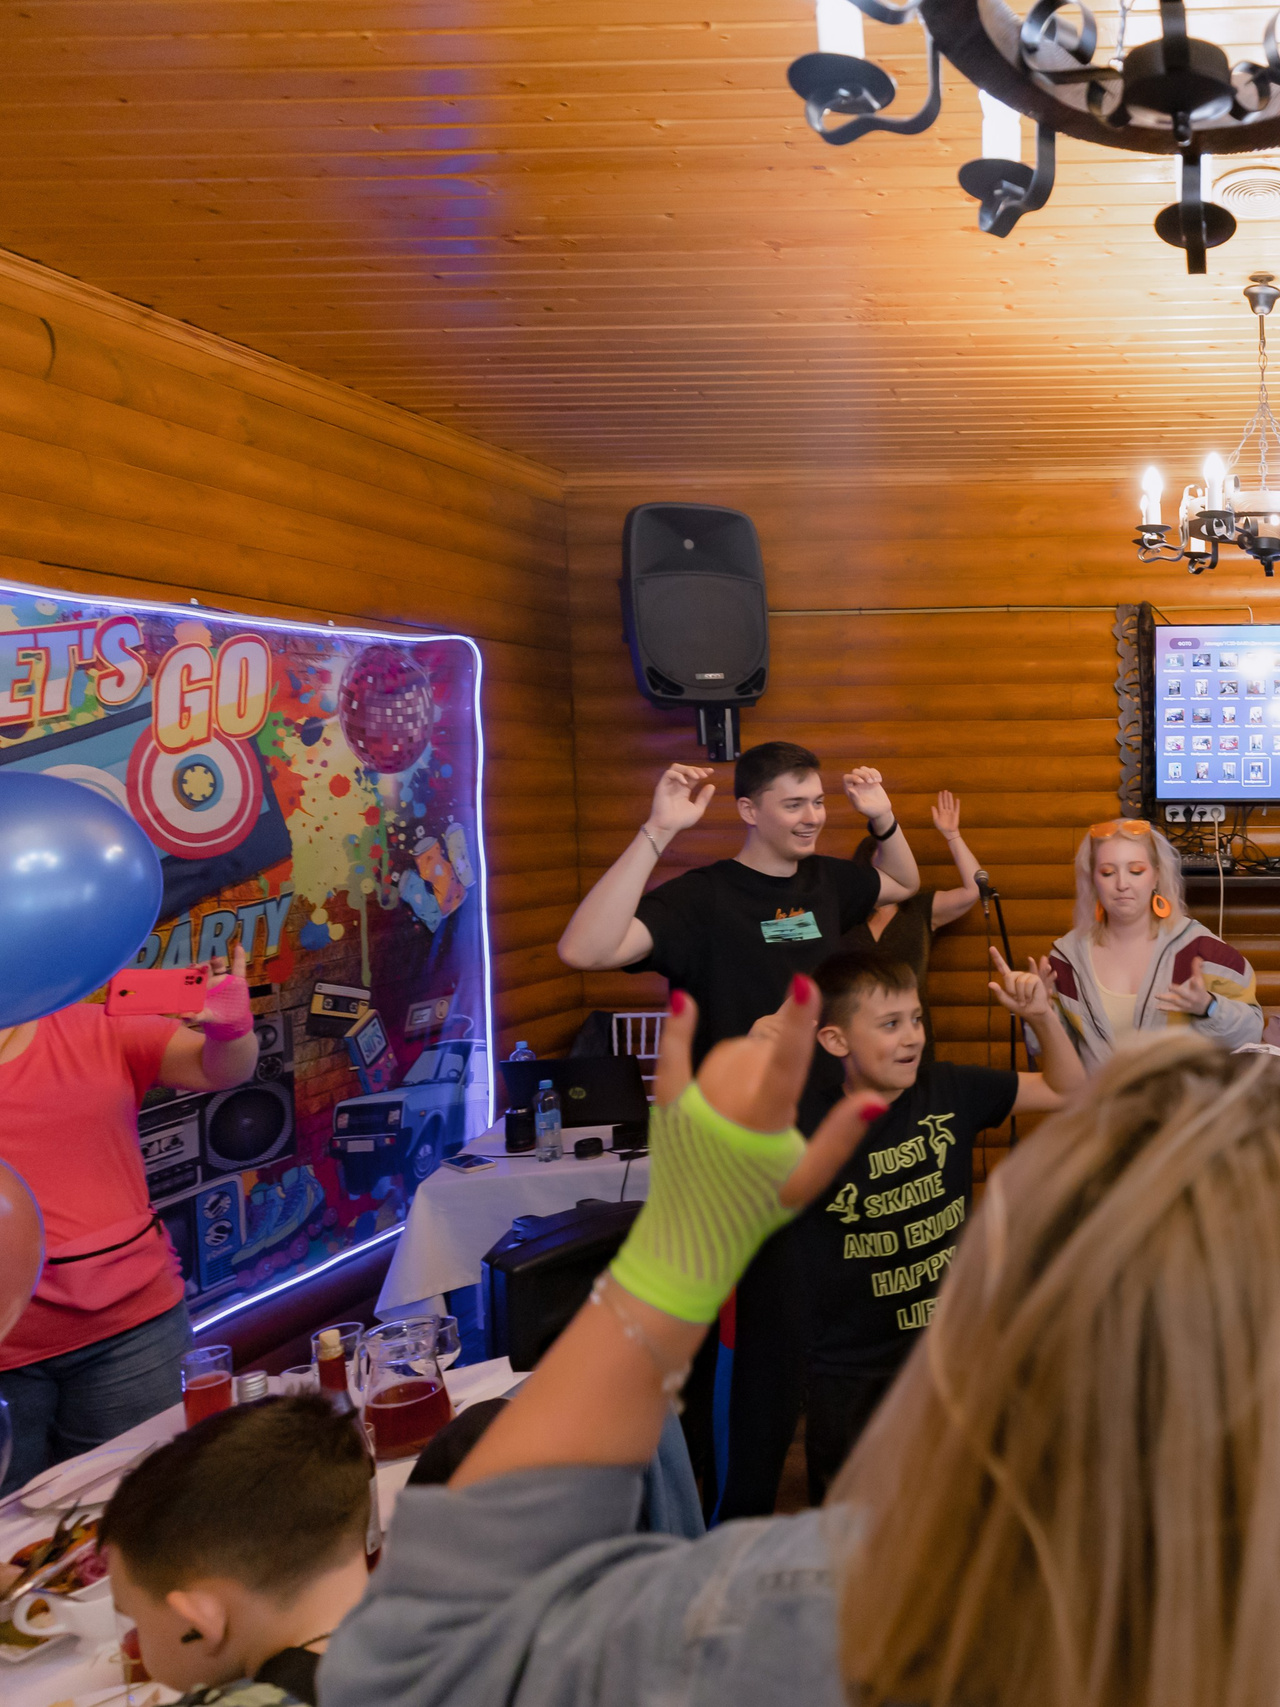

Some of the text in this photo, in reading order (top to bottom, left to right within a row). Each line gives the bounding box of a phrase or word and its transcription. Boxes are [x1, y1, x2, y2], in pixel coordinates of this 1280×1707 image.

[0, 613, 271, 754] ET'S GO
[124, 890, 294, 971] PARTY
[868, 1135, 927, 1180] JUST
[863, 1171, 946, 1219] SKATE
[843, 1195, 965, 1259] AND ENJOY
[871, 1246, 957, 1298] HAPPY
[897, 1298, 939, 1330] LIF
